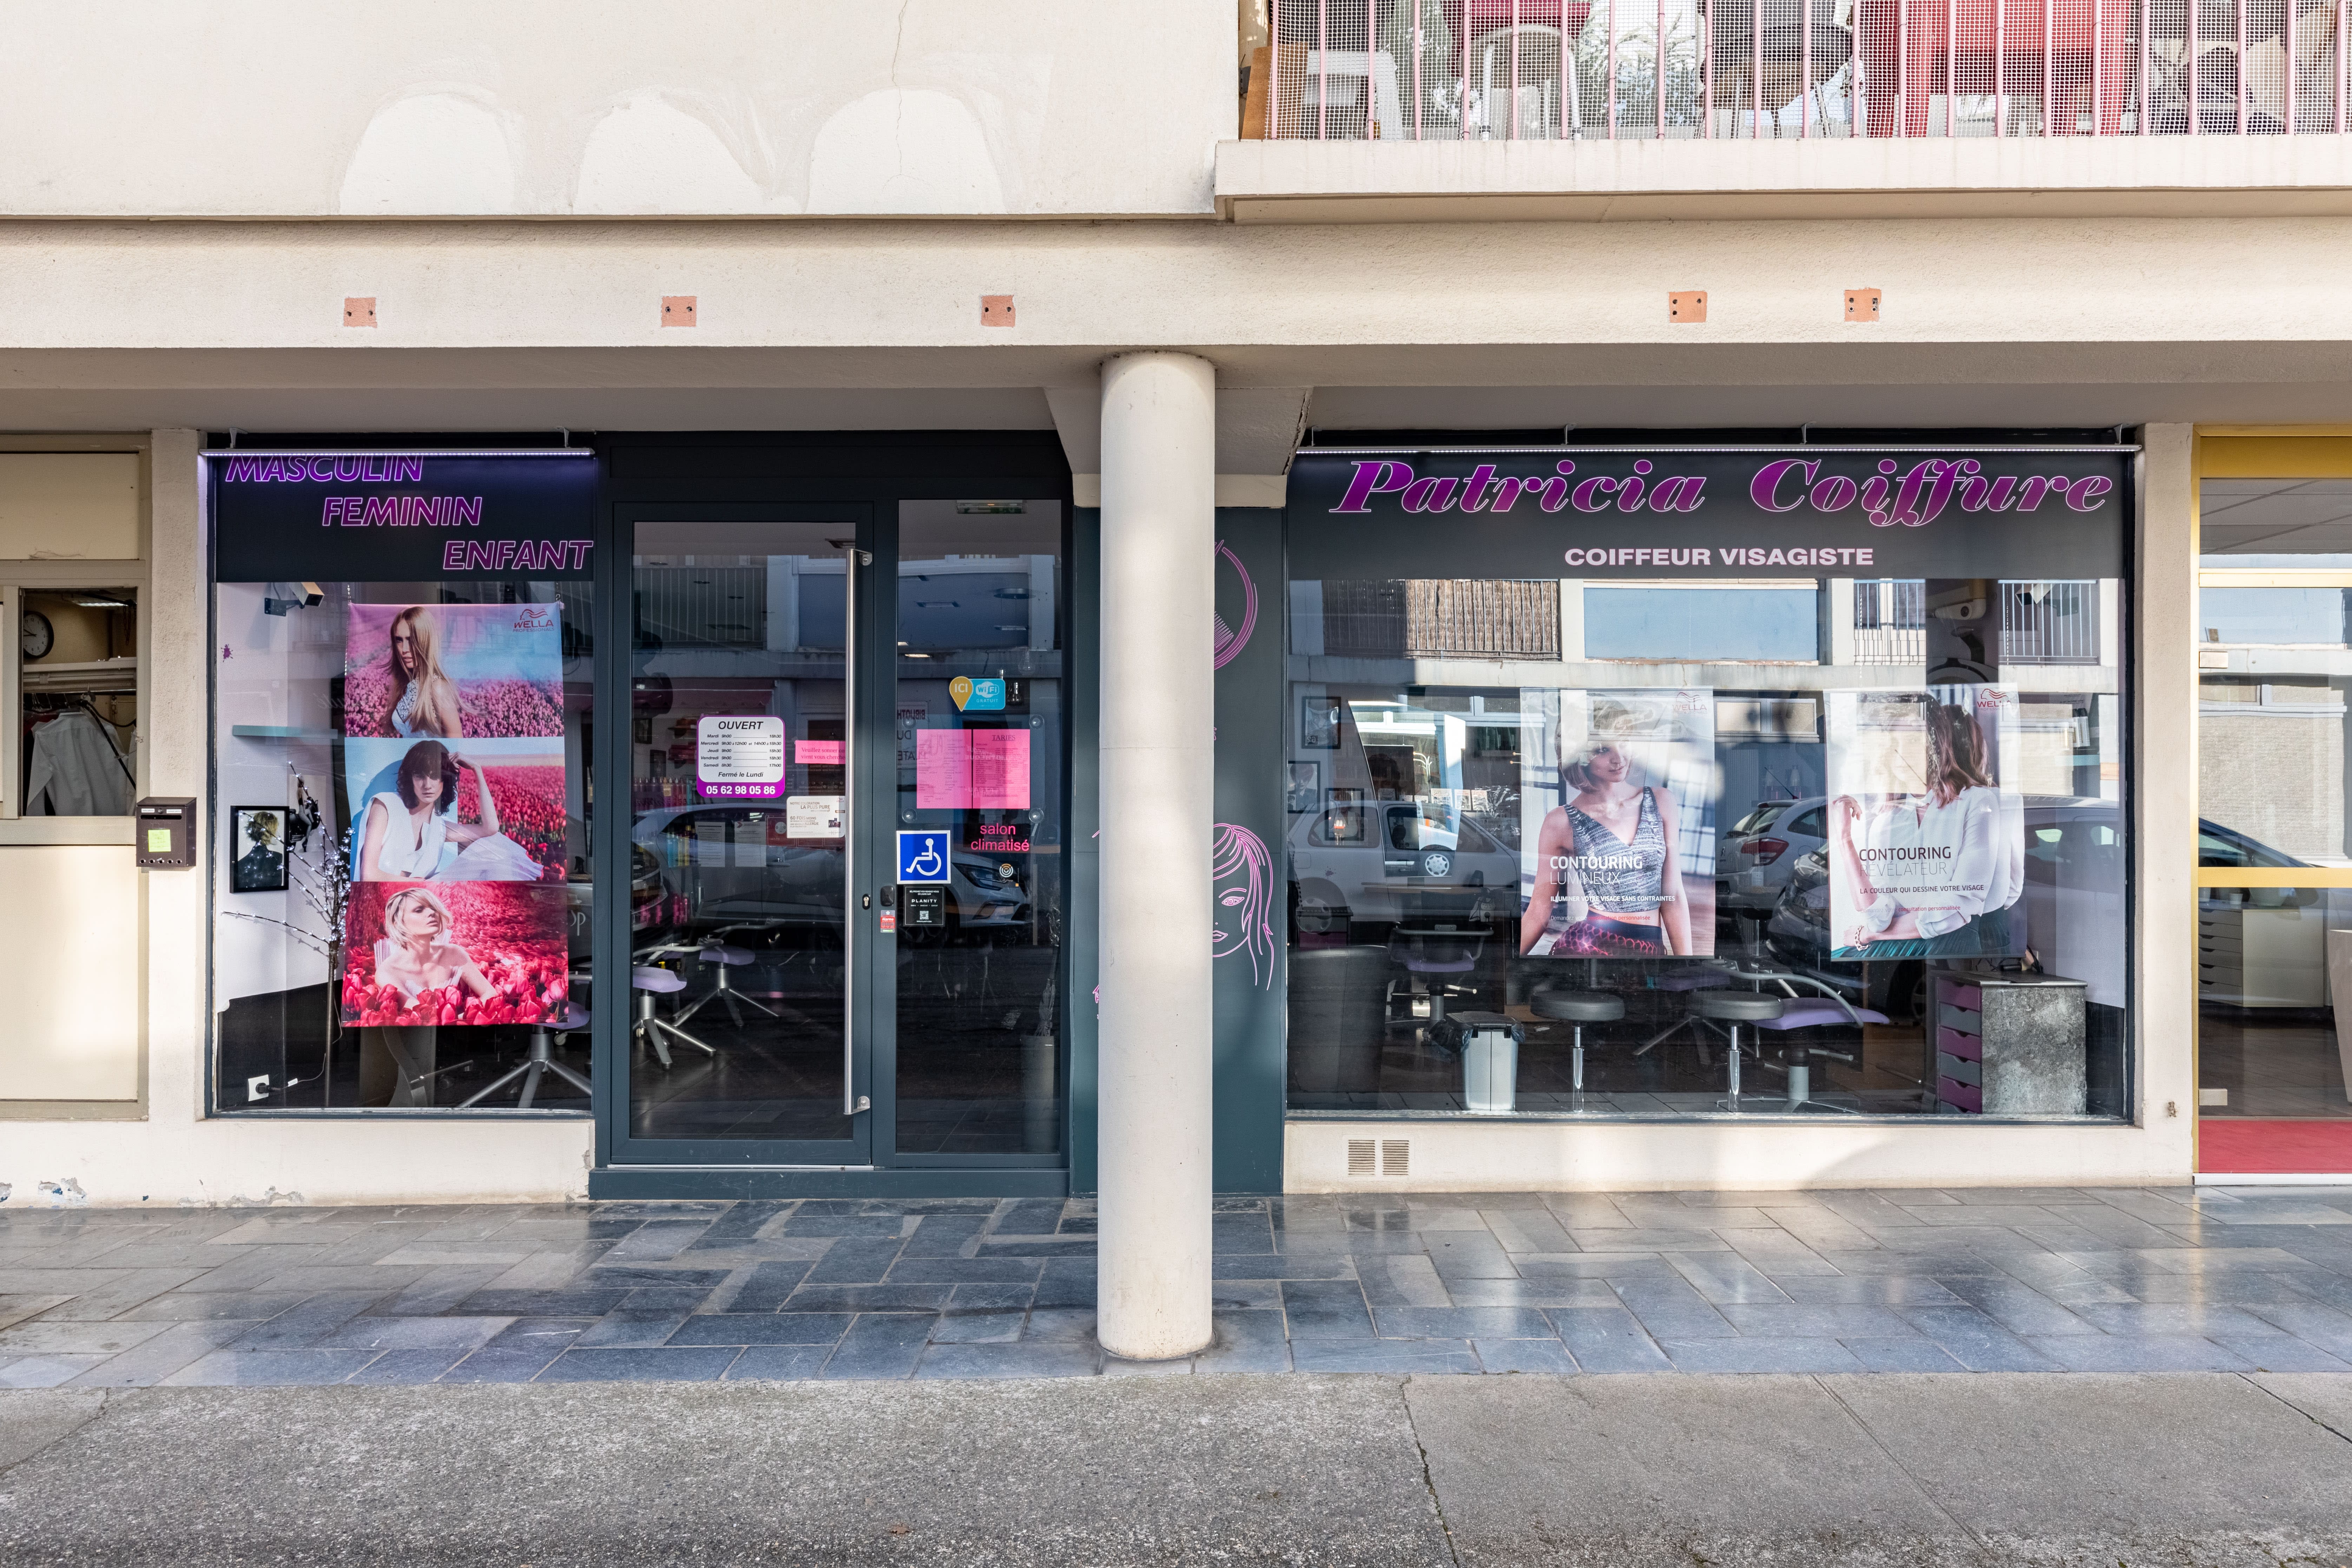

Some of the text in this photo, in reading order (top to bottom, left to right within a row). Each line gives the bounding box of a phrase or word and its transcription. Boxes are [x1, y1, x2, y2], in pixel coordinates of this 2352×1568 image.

[225, 455, 423, 482] MASCULIN
[1329, 459, 2113, 527] Patricia Coiffure
[322, 497, 482, 526] FEMININ
[443, 540, 594, 570] ENFANT
[1564, 548, 1874, 566] COIFFEUR VISAGISTE
[514, 620, 554, 628] WELLA
[954, 683, 968, 693] ICI
[718, 721, 764, 730] OUVERT
[706, 786, 776, 795] 05 62 98 05 86
[980, 823, 1016, 835] salon
[971, 838, 1030, 851] climatisé
[1859, 846, 1951, 861] CONTOURING
[1550, 856, 1643, 869] CONTOURING
[1860, 861, 1947, 877] RÉVÉLATEUR
[1550, 872, 1621, 884] LUMINEUX
